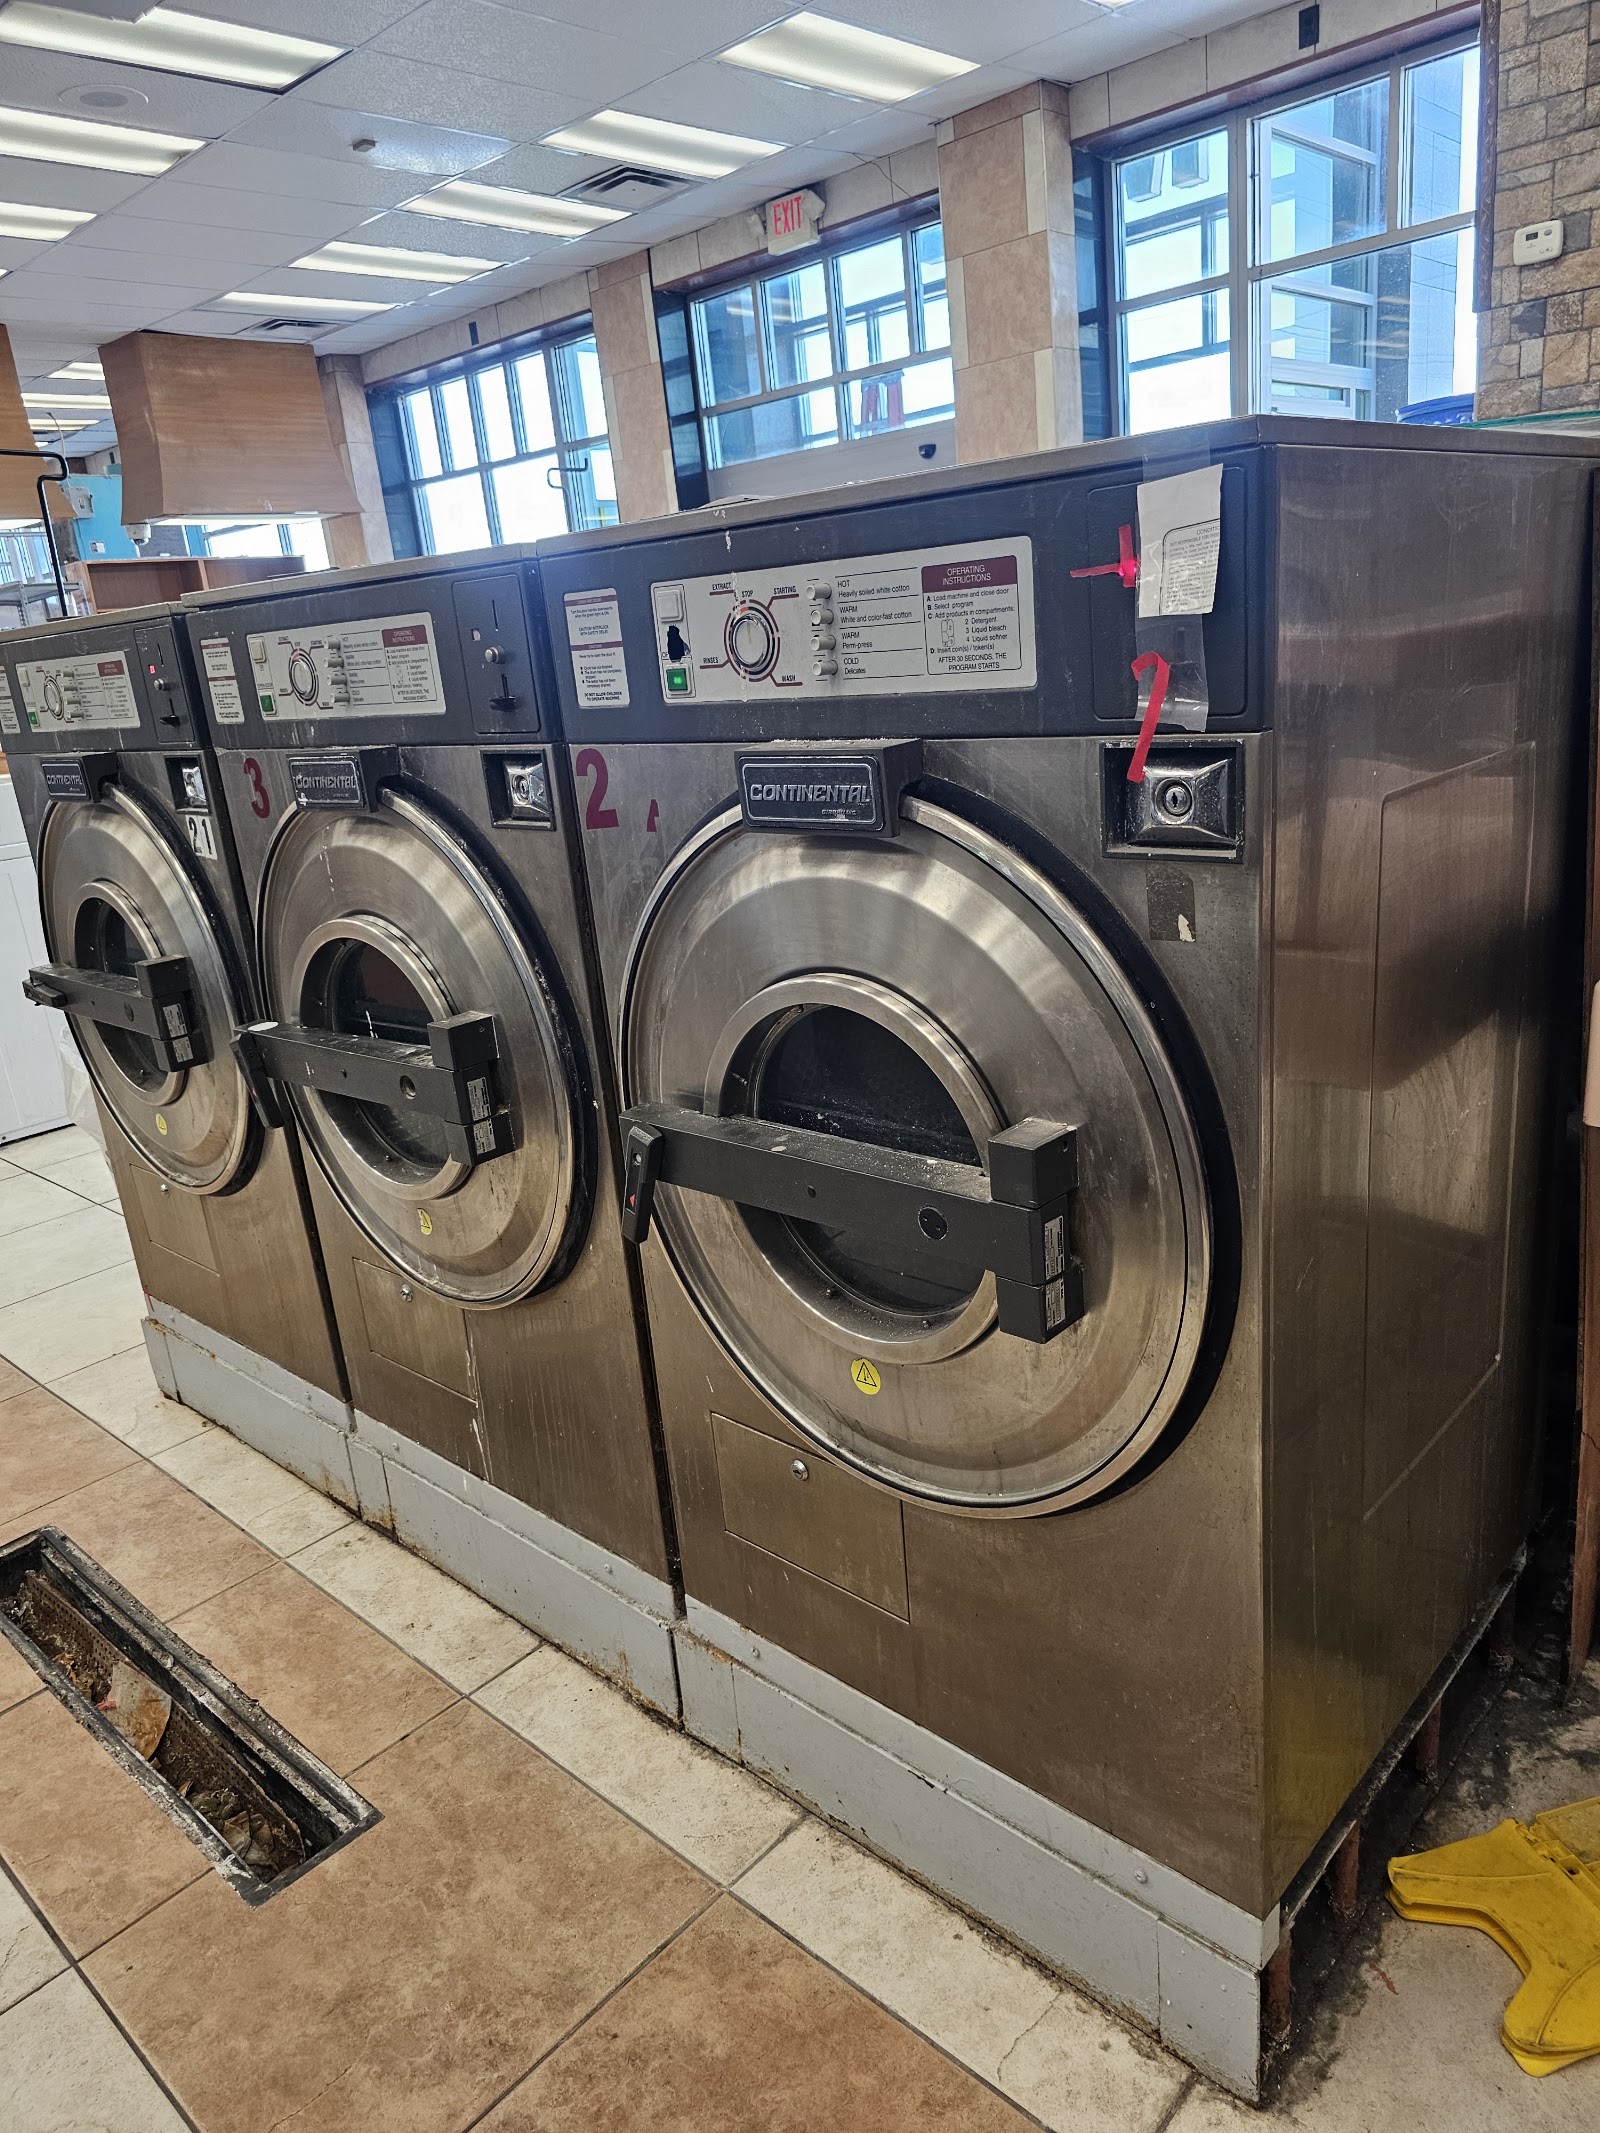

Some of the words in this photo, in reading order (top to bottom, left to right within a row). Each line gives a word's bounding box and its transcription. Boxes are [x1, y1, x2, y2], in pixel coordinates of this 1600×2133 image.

[773, 195, 803, 236] EXIT
[947, 565, 985, 576] OPERATING
[942, 573, 991, 585] INSTRUCTIONS
[712, 582, 732, 590] EXTRACT
[837, 580, 850, 588] HOT
[741, 590, 753, 598] STOP
[773, 586, 797, 595] STARTING
[838, 590, 858, 598] Heavily
[947, 592, 968, 600] machine
[839, 605, 858, 613] WARM
[952, 601, 974, 609] program
[867, 612, 893, 621] color-fast
[894, 611, 912, 619] cotton
[946, 609, 968, 618] products
[975, 606, 1015, 615] compartments:
[971, 616, 997, 625] Detergent
[841, 631, 860, 639] WARM
[842, 642, 873, 650] Perm-press
[952, 645, 969, 653] coin(s)
[973, 643, 995, 651] token(s)
[703, 656, 719, 664] RINSES
[843, 657, 859, 665] COLD
[948, 663, 977, 671] PROGRAM
[977, 661, 1000, 669] STARTS
[844, 667, 867, 675] Delicates
[781, 674, 796, 682] WASH
[47, 774, 83, 785] CONTINENTAL
[295, 774, 356, 789] CONTINENTAL
[243, 757, 270, 819] 3
[576, 748, 619, 830] 2
[750, 783, 871, 803] CONTINENTAL
[188, 816, 213, 855] 21
